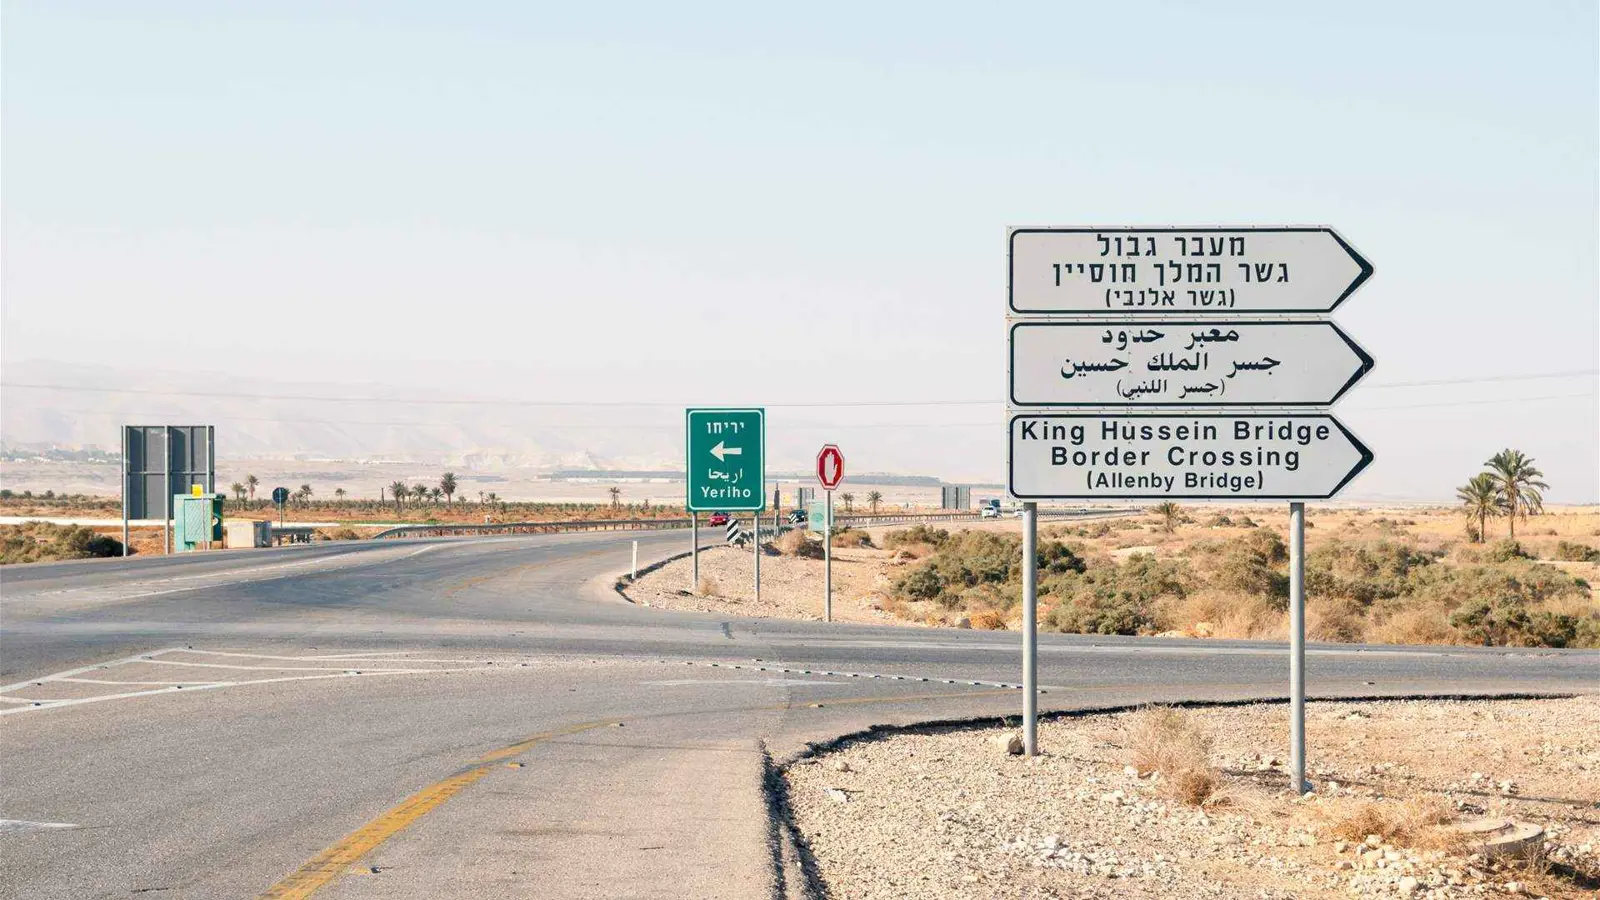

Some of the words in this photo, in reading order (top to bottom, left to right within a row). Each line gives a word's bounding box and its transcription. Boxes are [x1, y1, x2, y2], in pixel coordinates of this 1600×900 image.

[1097, 234, 1156, 256] גבול
[1174, 236, 1244, 256] מעבר
[1053, 264, 1135, 286] חוסיין
[1154, 260, 1220, 286] המלך
[1239, 263, 1288, 282] גשר
[1106, 288, 1174, 307] אלנבי)
[1187, 289, 1234, 307] (גשר
[1102, 330, 1165, 351] حدود
[1184, 329, 1239, 350] معبر
[1061, 359, 1129, 379] حسين
[1147, 352, 1207, 371] الملك
[1226, 357, 1280, 378] جسر
[1117, 379, 1167, 400] اللنبي)
[1179, 379, 1224, 399] (جسر
[706, 421, 745, 434] יריחו
[1022, 421, 1084, 445] King
[1102, 421, 1216, 440] Hussein
[1235, 421, 1329, 445] Bridge
[1052, 447, 1149, 466] Border
[1168, 446, 1299, 471] Crossing
[701, 486, 751, 498] Yeriho
[1087, 471, 1174, 492] (Allenby
[1185, 471, 1263, 492] Bridge)
